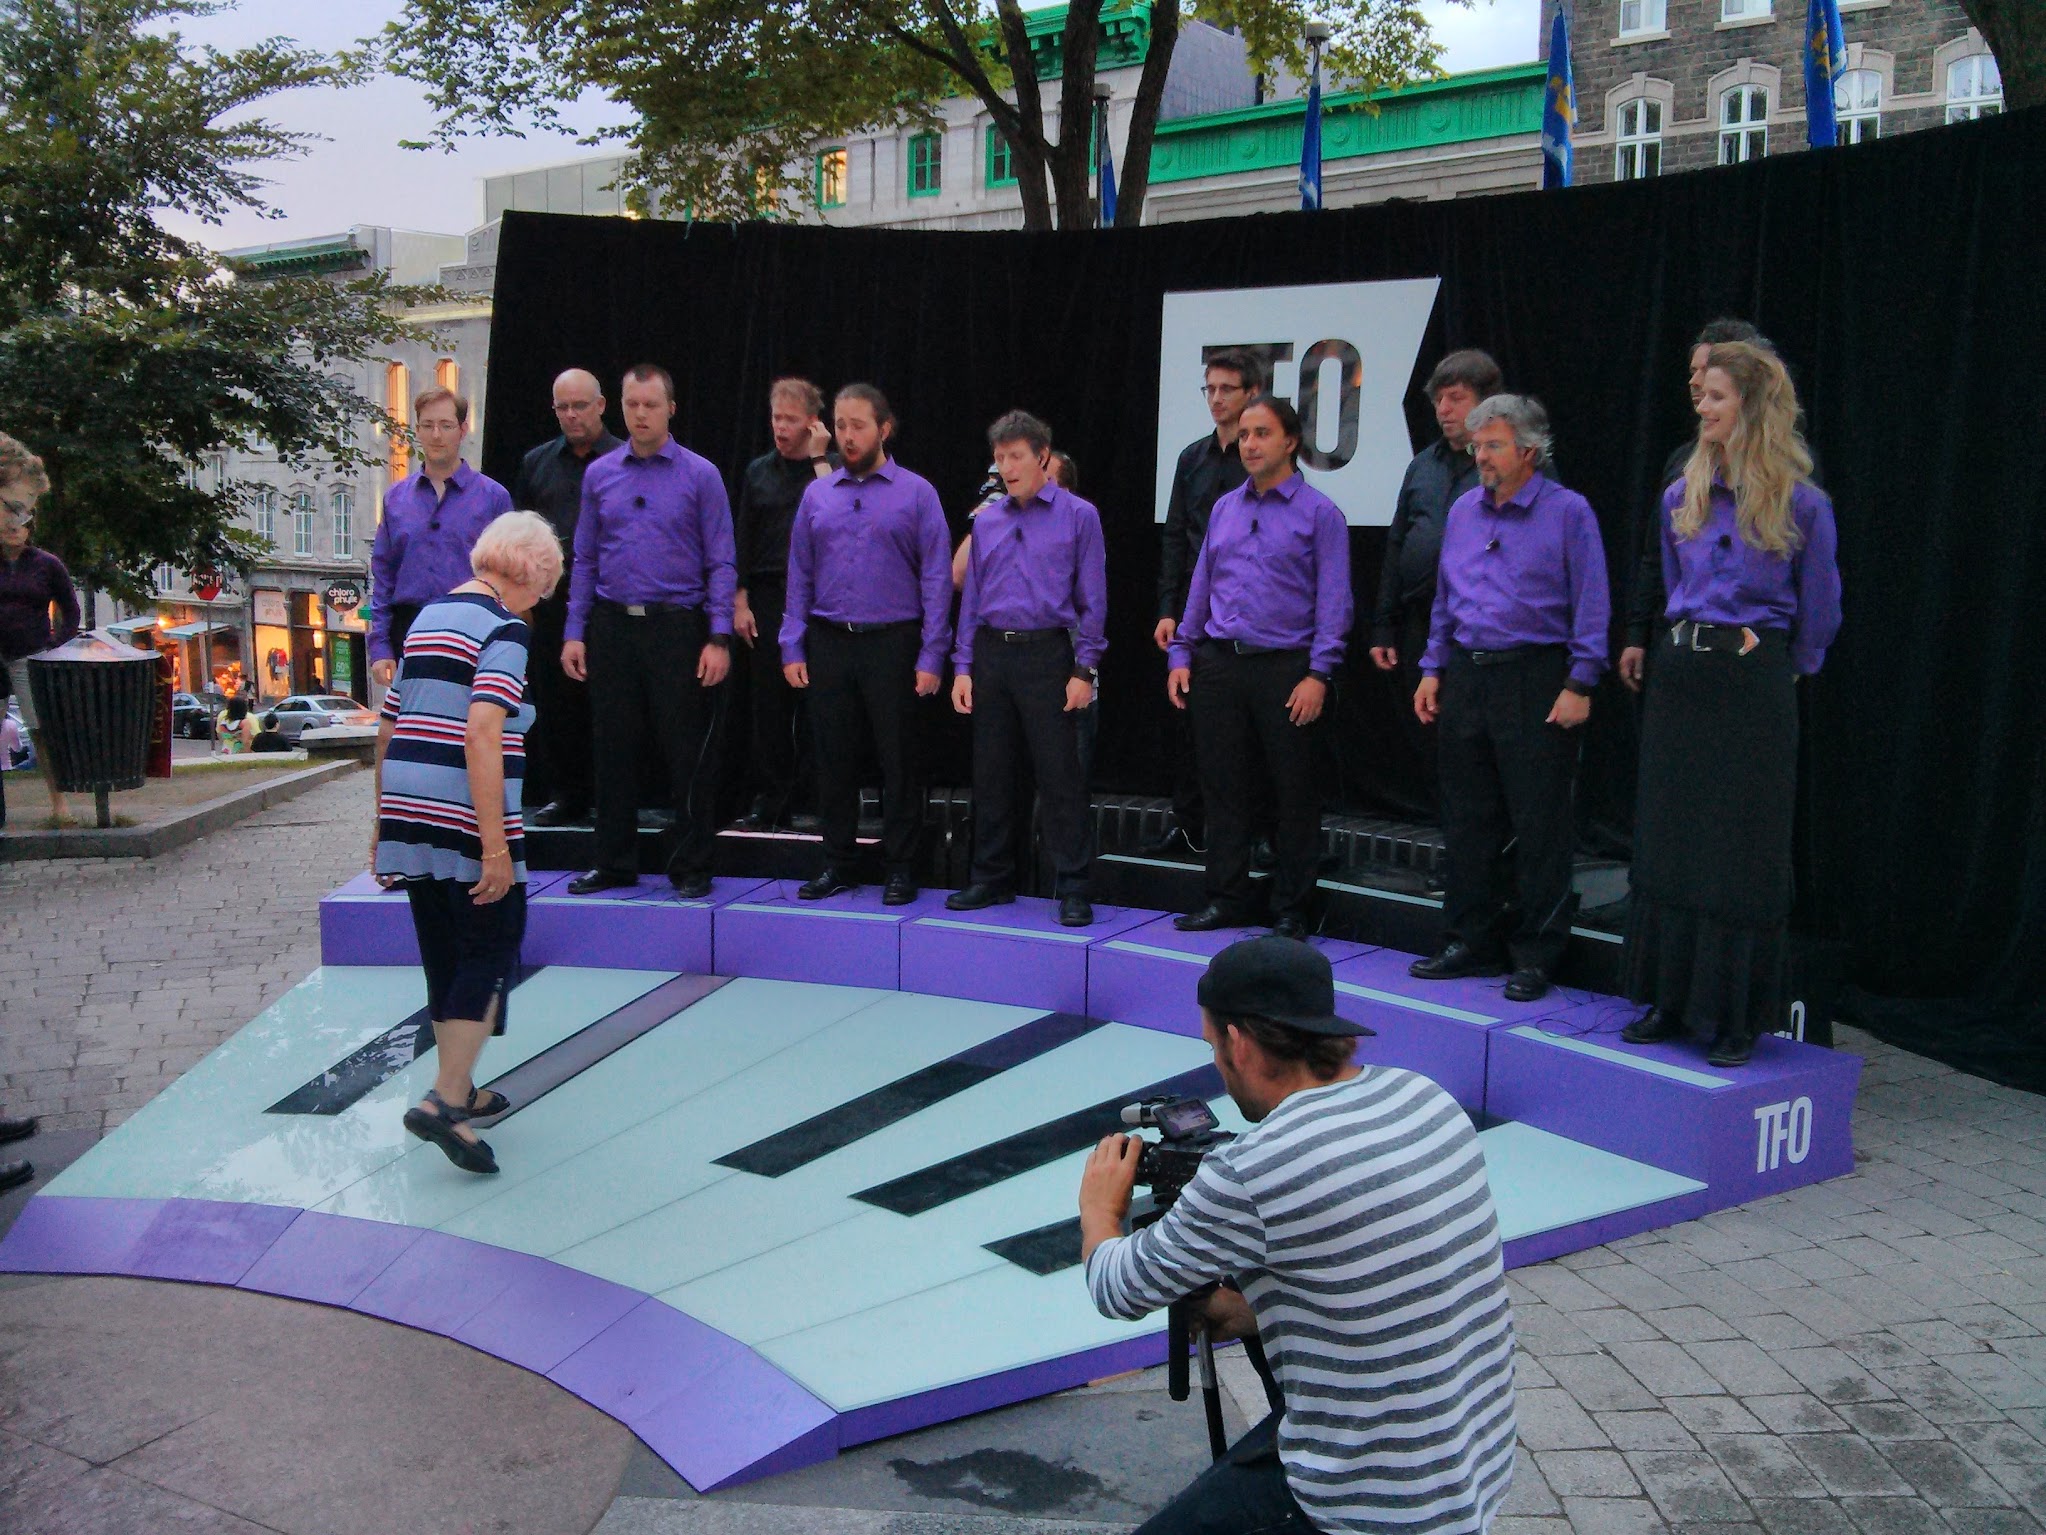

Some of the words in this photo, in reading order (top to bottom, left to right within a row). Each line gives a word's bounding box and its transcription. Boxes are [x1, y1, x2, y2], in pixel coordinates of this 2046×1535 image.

[1201, 338, 1362, 472] FO
[328, 588, 355, 597] chloro
[1754, 1096, 1813, 1174] TFO
